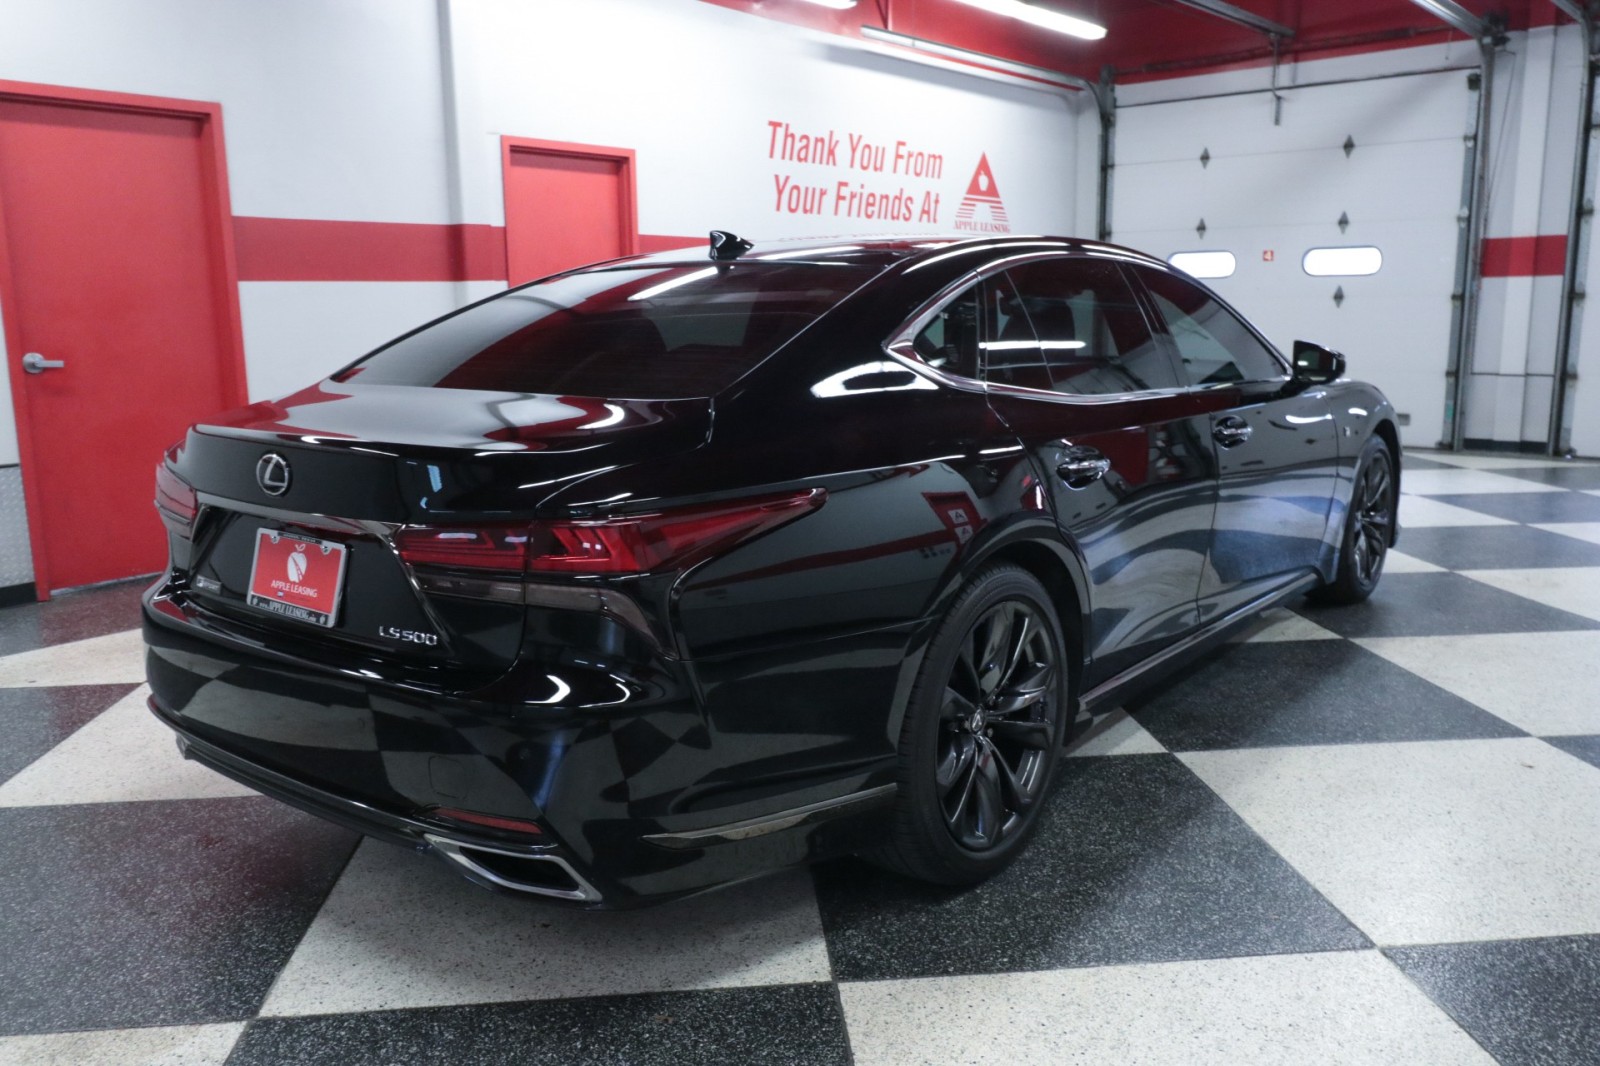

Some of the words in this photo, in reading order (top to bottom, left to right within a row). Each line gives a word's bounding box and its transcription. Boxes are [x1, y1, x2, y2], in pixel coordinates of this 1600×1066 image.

[768, 120, 839, 166] Thank
[848, 133, 885, 172] You
[893, 140, 943, 179] From
[774, 175, 827, 215] Your
[834, 181, 914, 222] Friends
[919, 190, 941, 223] At
[953, 219, 978, 231] APPLE
[980, 221, 1011, 234] LEASING
[270, 580, 291, 592] APPLE
[291, 584, 318, 598] LEASING
[379, 625, 400, 639] LS
[401, 630, 438, 646] 500
